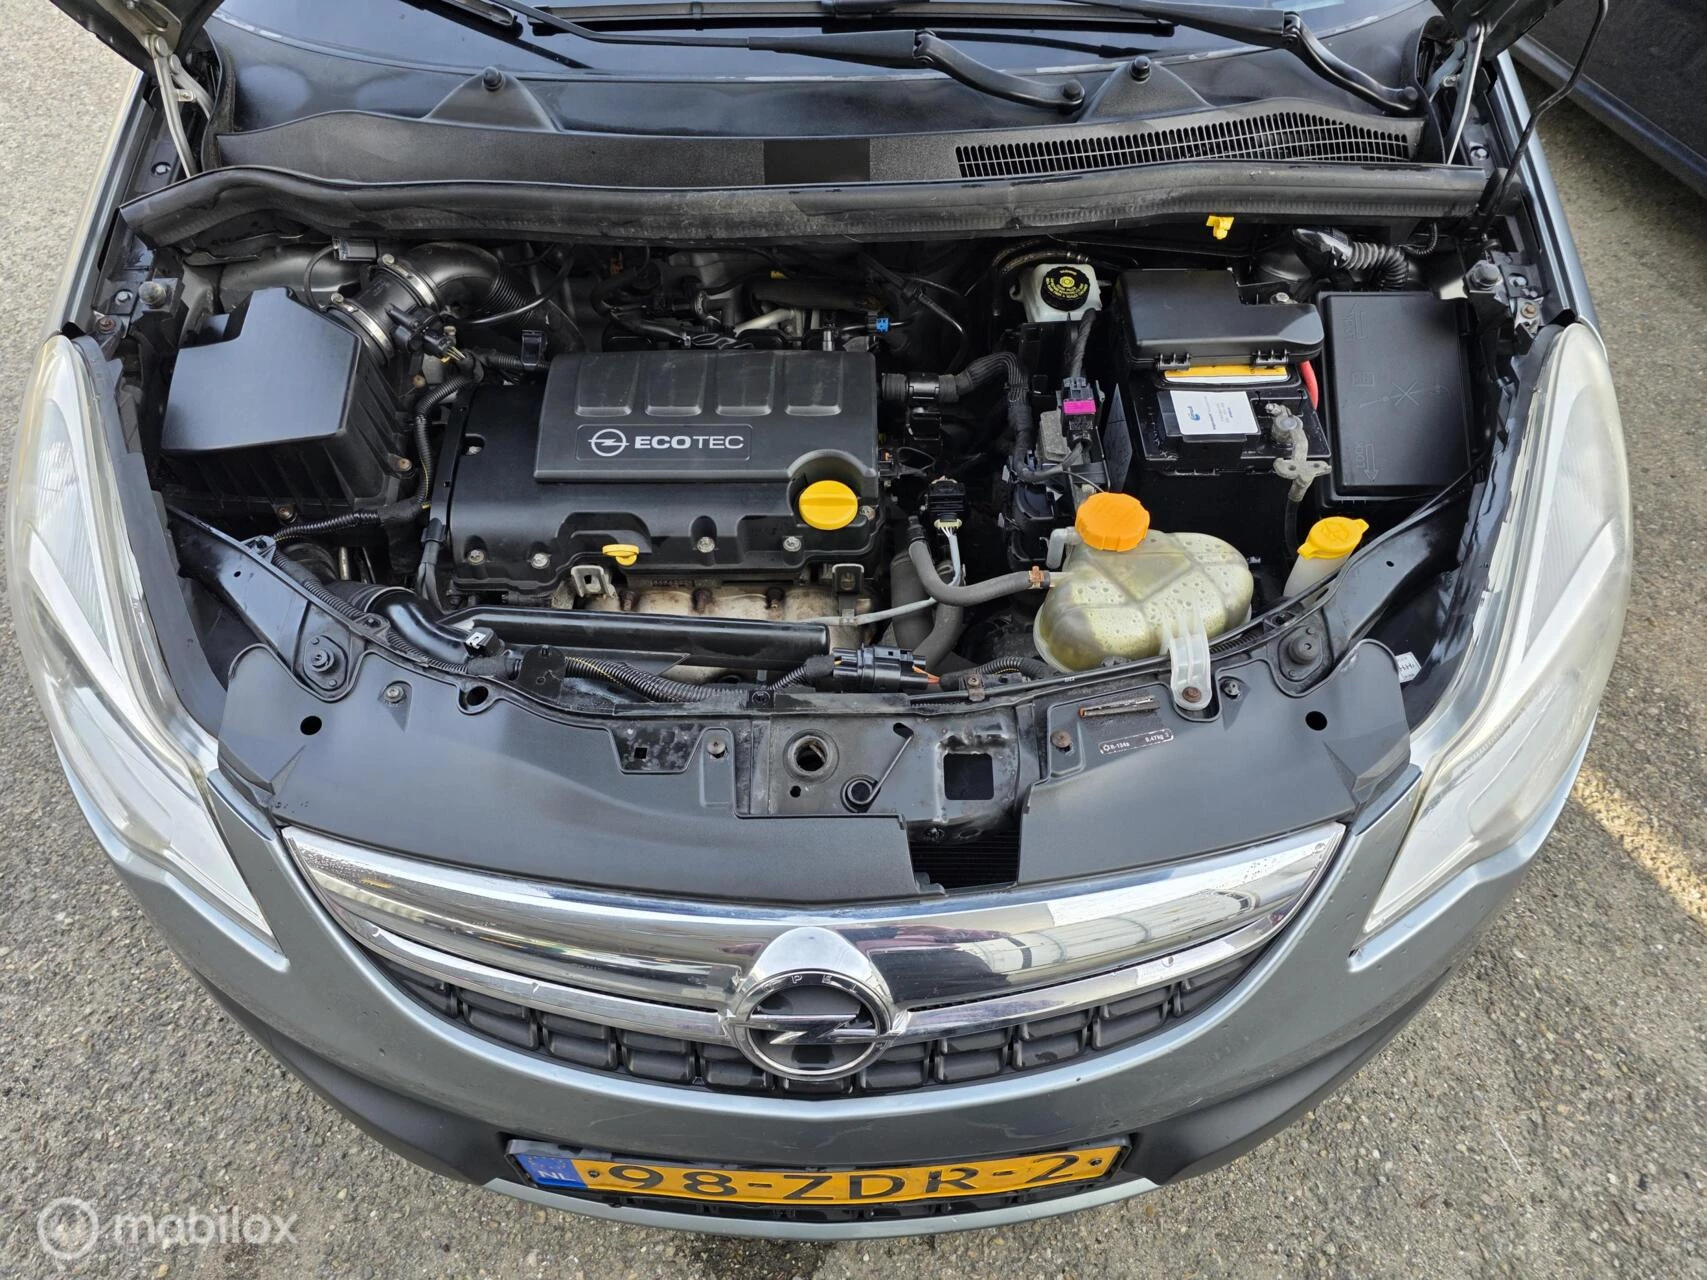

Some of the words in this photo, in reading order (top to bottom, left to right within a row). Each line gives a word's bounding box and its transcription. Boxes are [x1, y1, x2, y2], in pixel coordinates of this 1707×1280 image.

[634, 436, 744, 449] ECOTEC
[762, 975, 857, 993] OPEL
[538, 1169, 577, 1182] NL
[608, 1154, 1080, 1200] 98-ZDR-2
